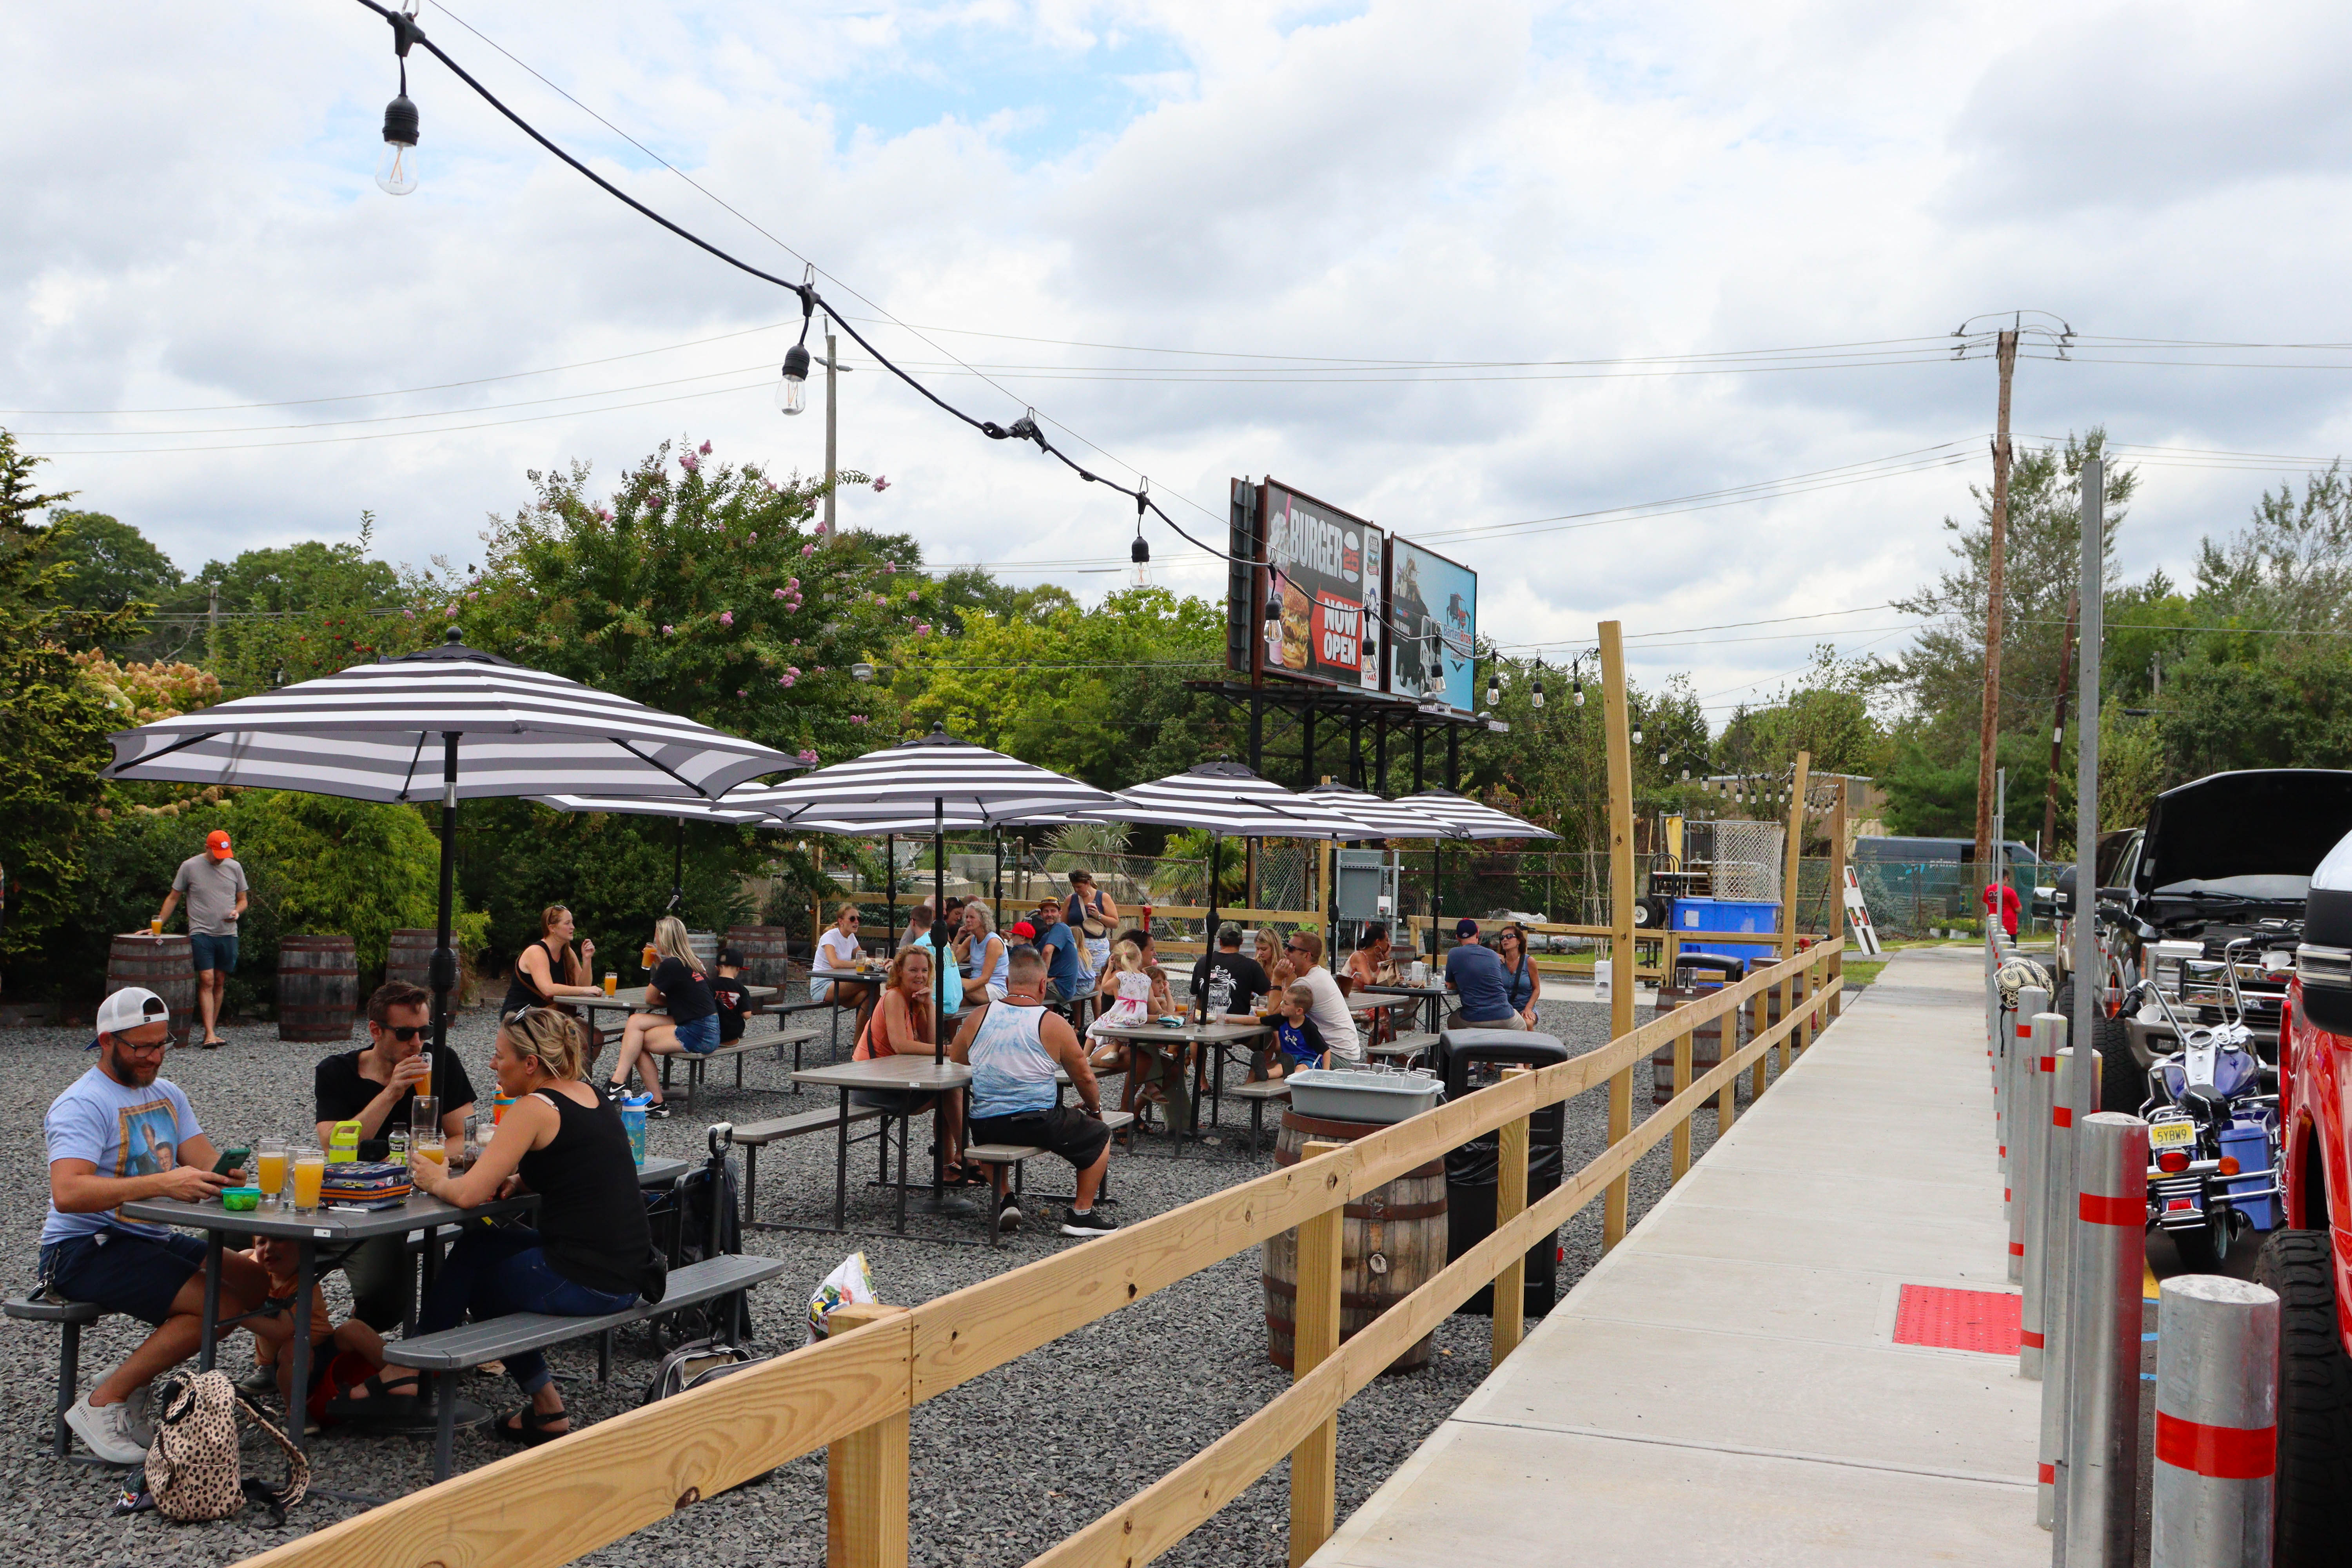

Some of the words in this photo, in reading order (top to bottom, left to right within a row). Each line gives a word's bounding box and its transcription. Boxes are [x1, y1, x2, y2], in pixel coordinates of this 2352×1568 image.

[1290, 508, 1343, 580] BURGER
[1343, 546, 1359, 572] 25
[1324, 598, 1358, 637] NOW
[1323, 635, 1357, 666] OPEN
[2158, 1129, 2187, 1142] 5YBW9
